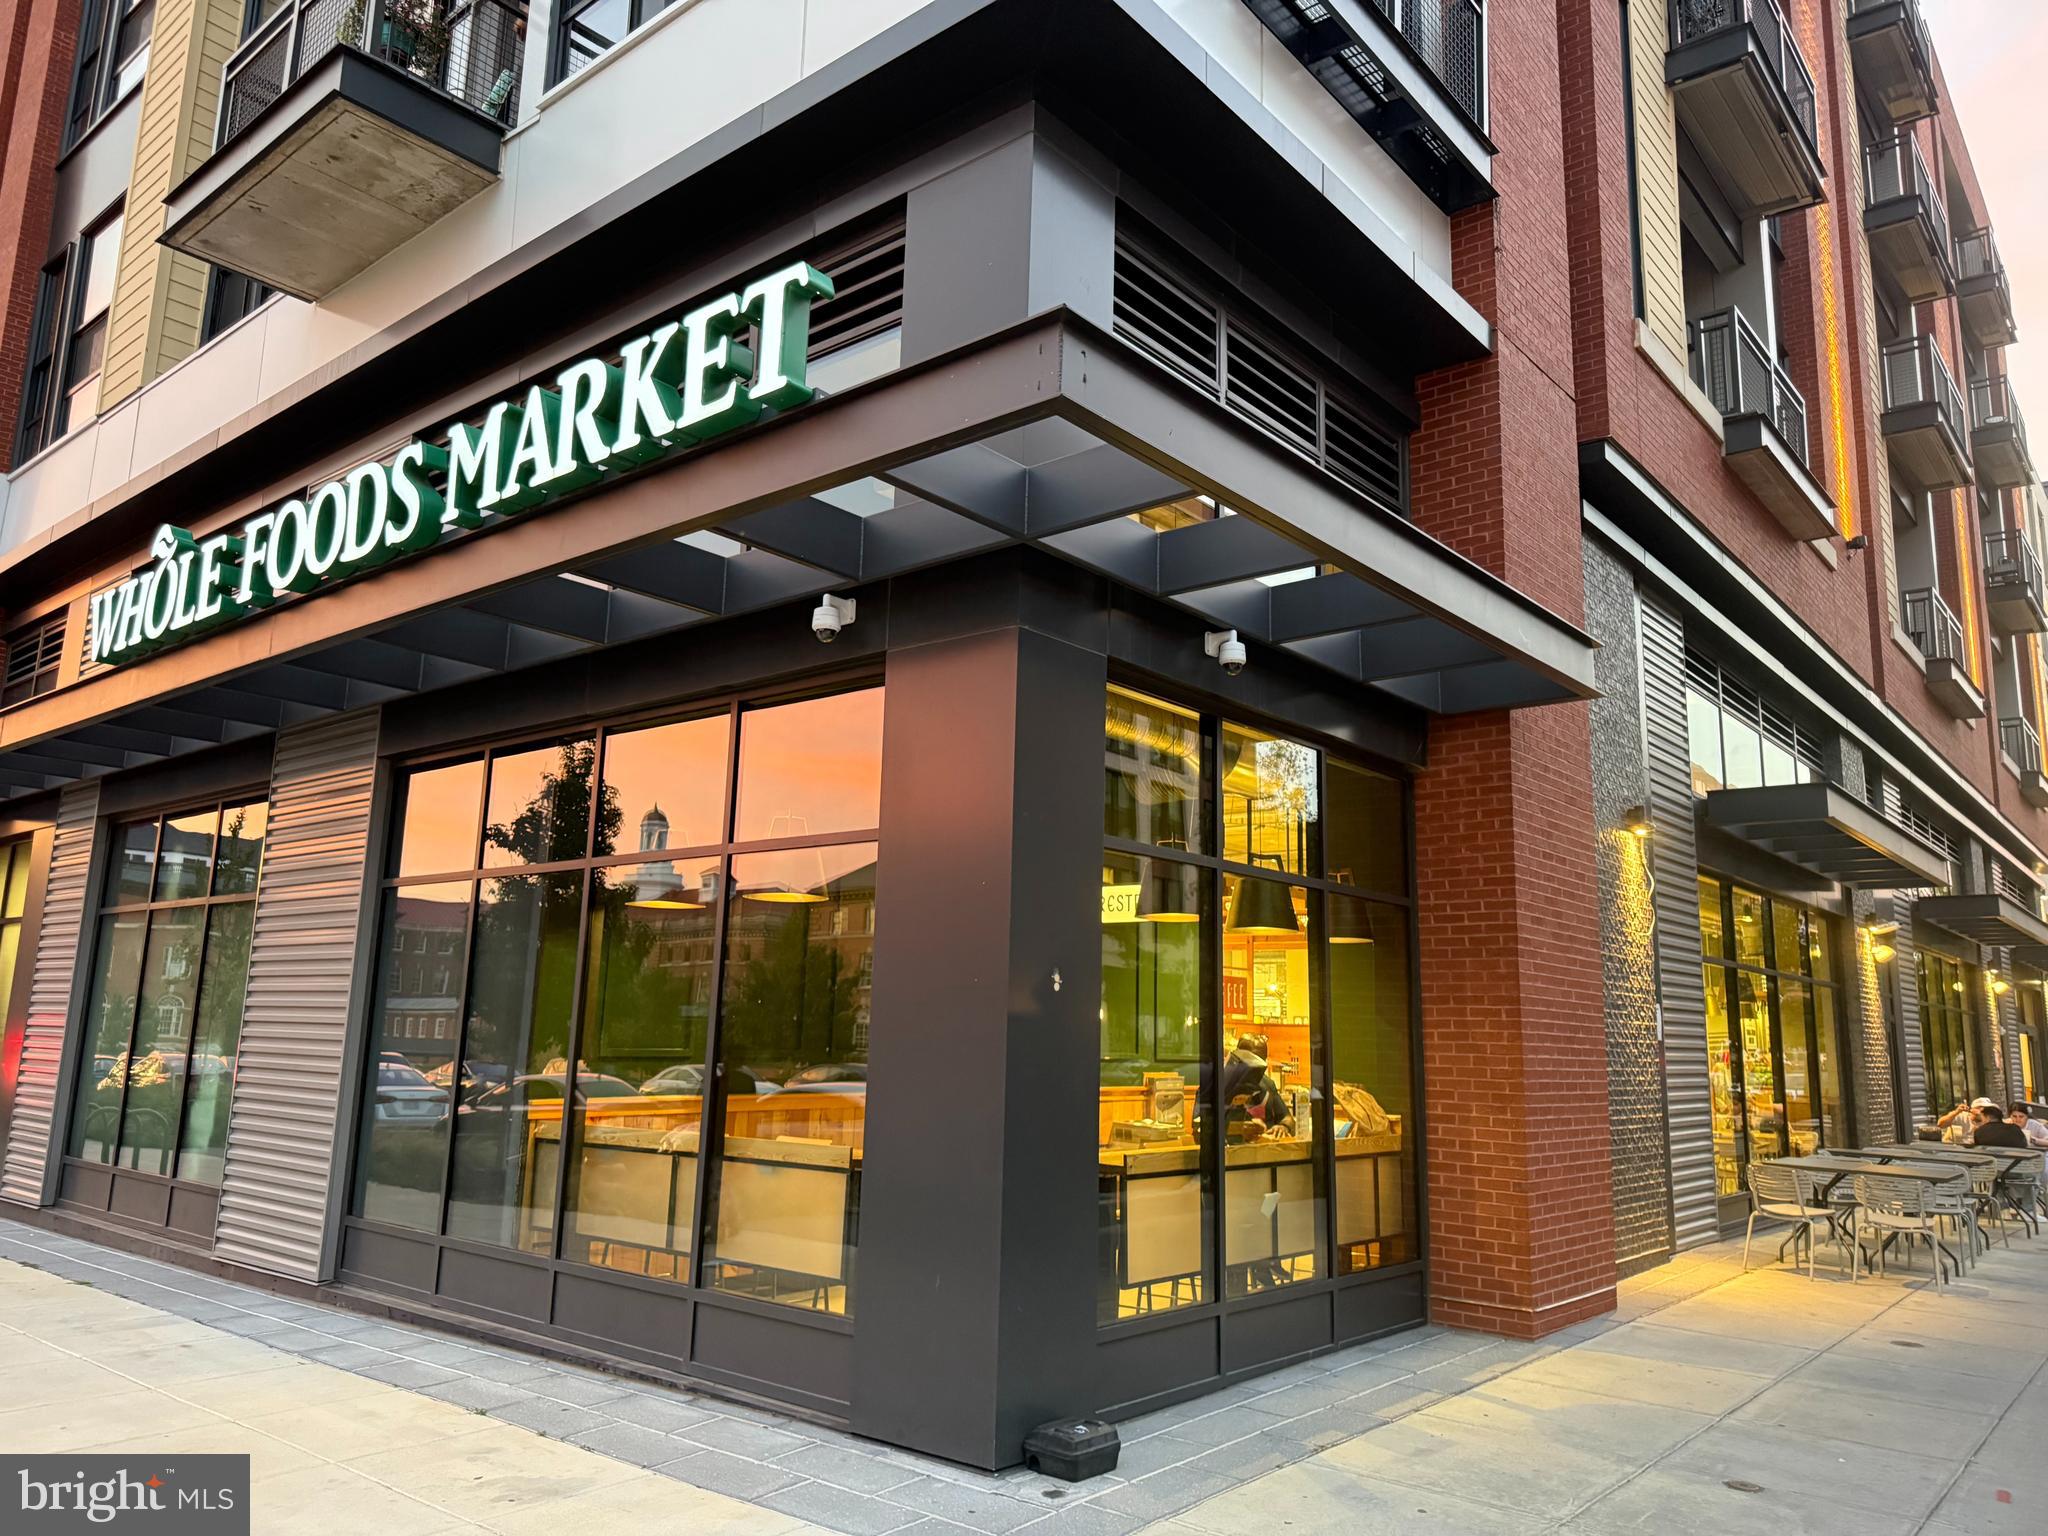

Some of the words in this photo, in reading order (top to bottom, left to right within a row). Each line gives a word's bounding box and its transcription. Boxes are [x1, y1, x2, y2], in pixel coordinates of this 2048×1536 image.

[91, 523, 228, 662] WHOLE
[236, 440, 424, 604] FOODS
[440, 261, 814, 524] MARKET
